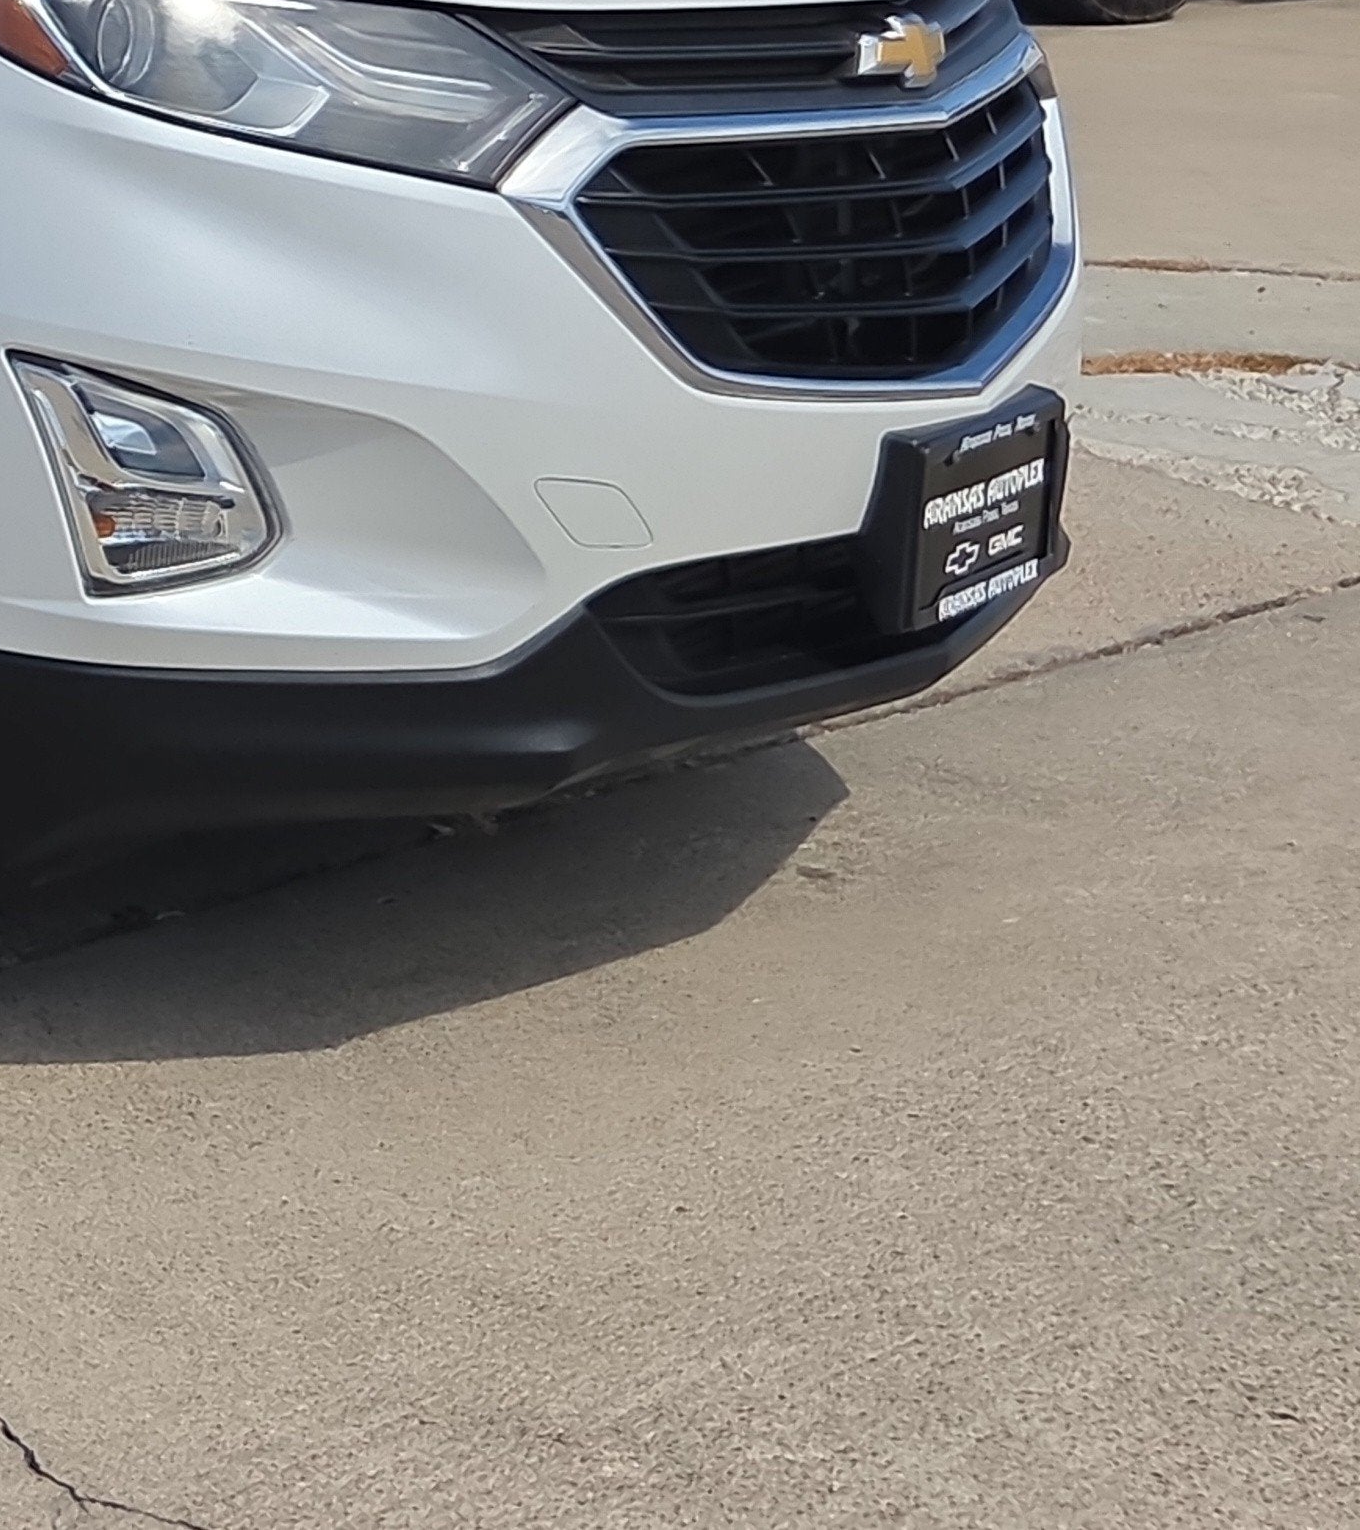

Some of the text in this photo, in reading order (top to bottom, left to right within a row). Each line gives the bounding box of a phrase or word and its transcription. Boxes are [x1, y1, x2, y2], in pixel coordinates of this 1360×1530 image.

[923, 458, 1045, 530] ARANSAS AUTOPLEX
[988, 524, 1024, 556] GMC
